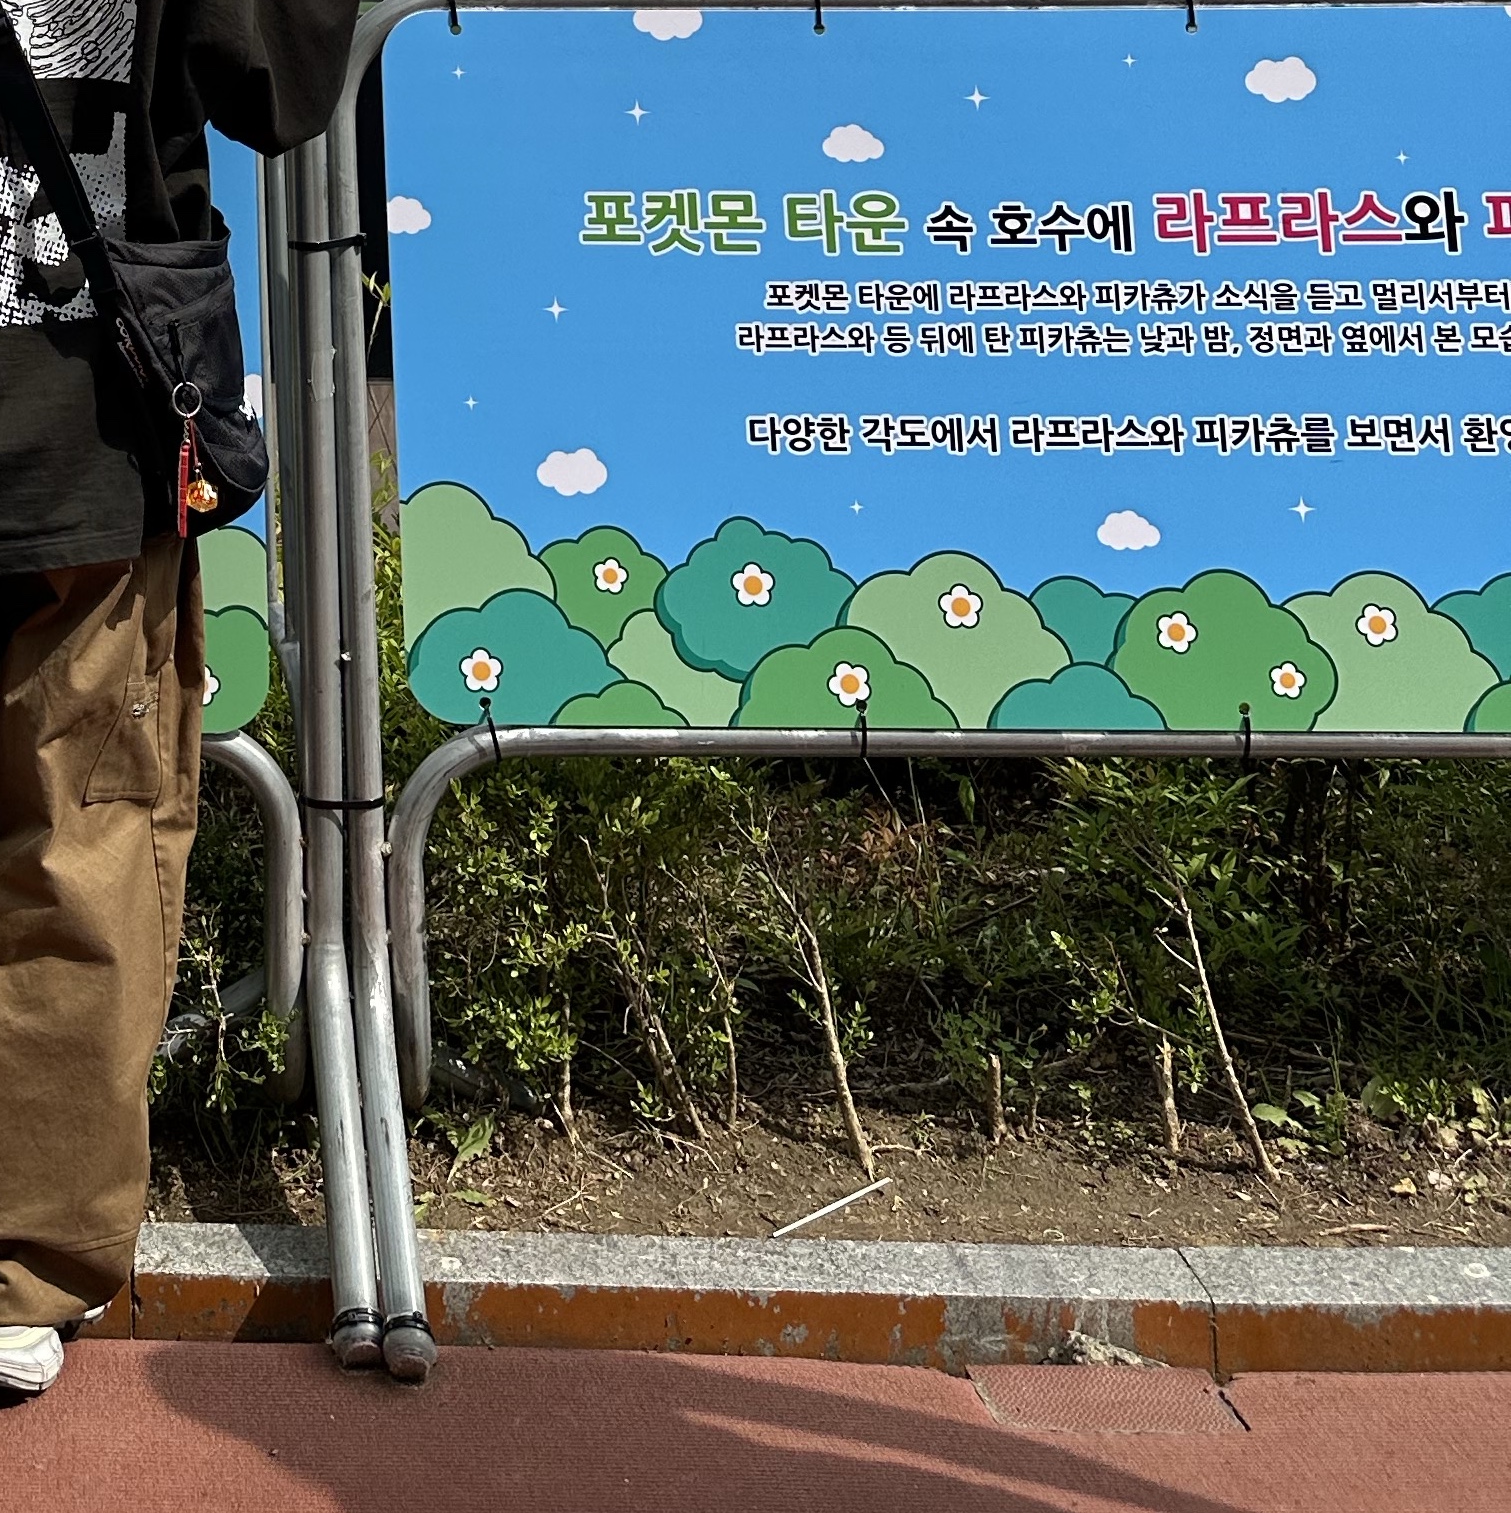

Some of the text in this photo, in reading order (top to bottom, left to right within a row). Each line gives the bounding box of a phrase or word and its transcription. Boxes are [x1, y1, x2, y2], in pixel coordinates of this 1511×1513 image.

[579, 191, 765, 255] 포켓몬
[785, 191, 907, 255] 타운
[925, 202, 976, 253] 속
[988, 202, 1134, 254] 호수에
[1153, 190, 1466, 254] 라프라스와
[765, 281, 1510, 312] 포켓몬 타운에 라프라스와 피카츄가 소식을 듣고 멀리서부터
[737, 324, 877, 354] 라프라스와
[883, 326, 912, 354] 등
[918, 324, 976, 355] 뒤에
[984, 324, 1012, 354] 탄
[1018, 324, 1131, 354] 피카츄는
[1140, 324, 1195, 354] 낮과
[1203, 324, 1241, 356] 밤,
[1248, 324, 1333, 354] 정면과
[1342, 324, 1425, 354] 옆에서
[1433, 325, 1463, 354] 본
[748, 416, 851, 454] 다양한
[861, 416, 1001, 454] 각도에서
[1011, 416, 1185, 454] 라프라스와
[1194, 416, 1336, 454] 피카츄를
[1346, 416, 1452, 454] 보면서
